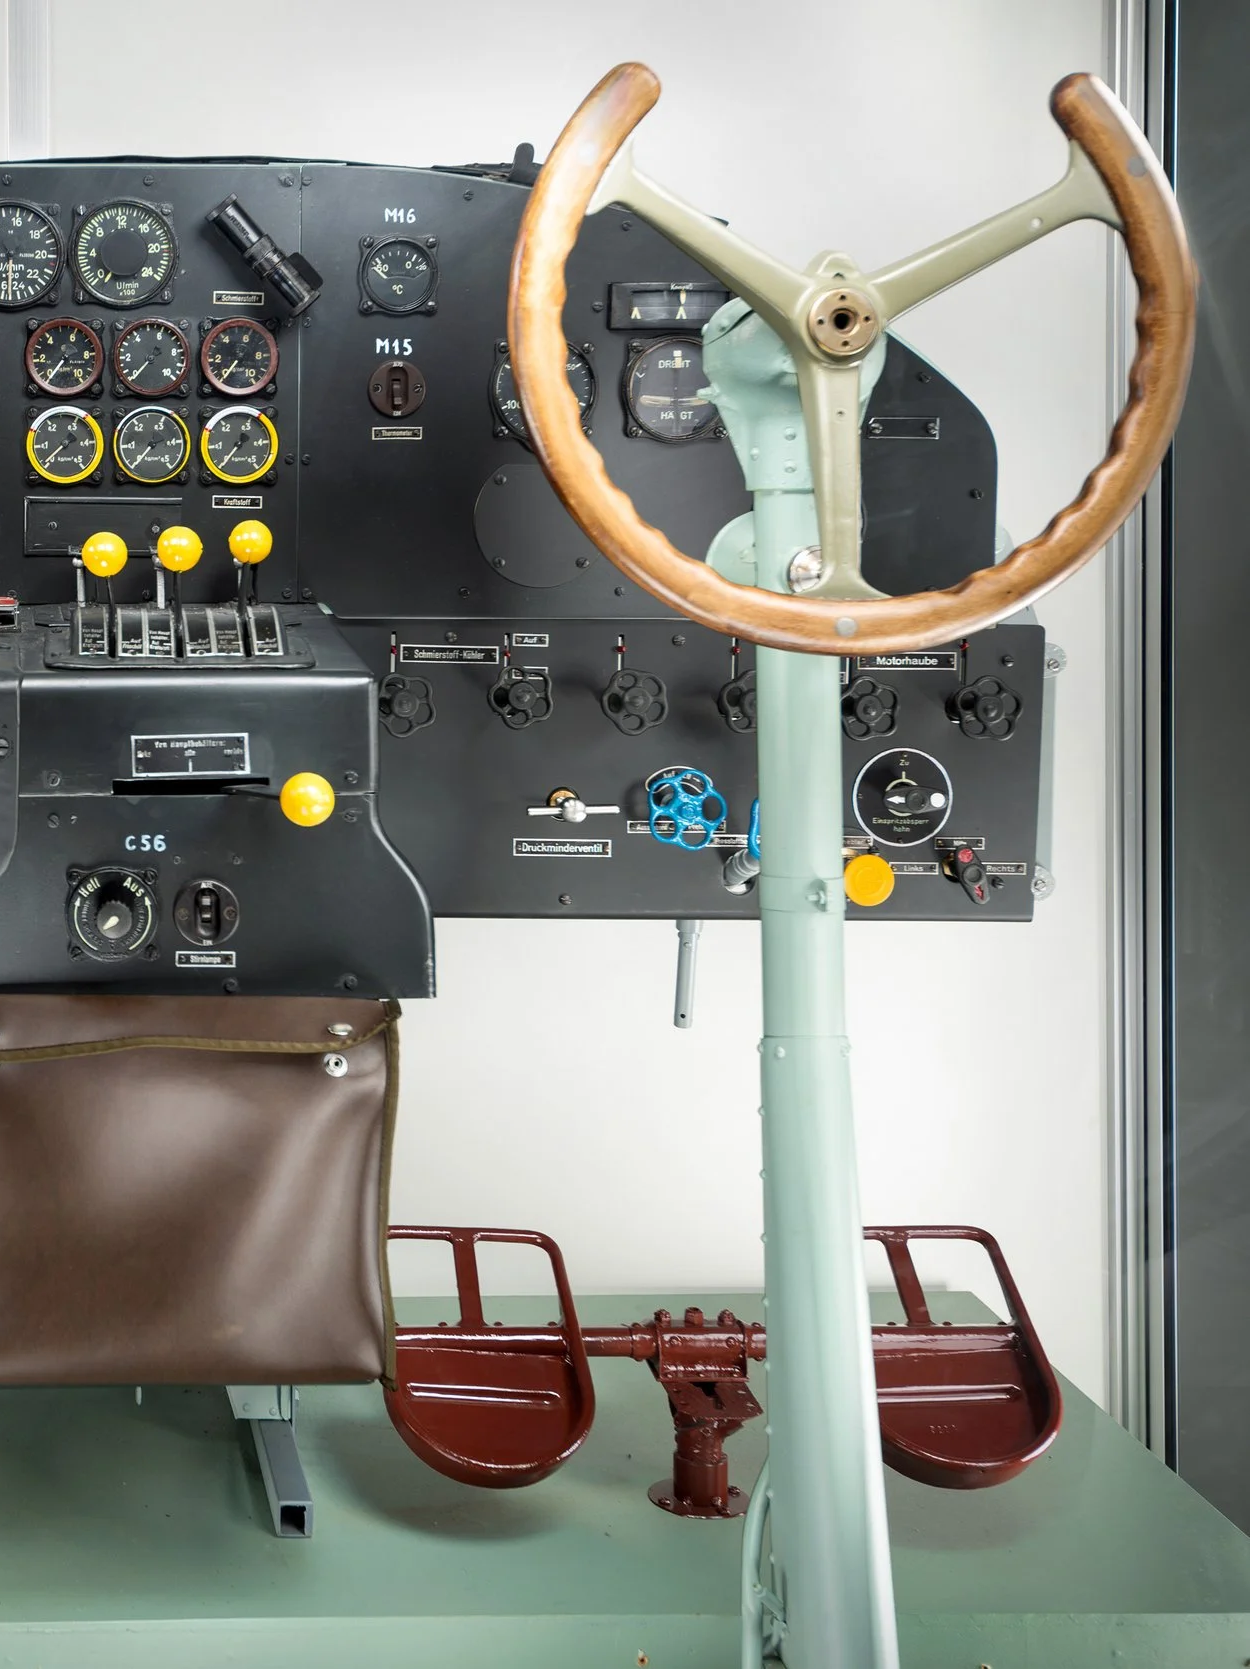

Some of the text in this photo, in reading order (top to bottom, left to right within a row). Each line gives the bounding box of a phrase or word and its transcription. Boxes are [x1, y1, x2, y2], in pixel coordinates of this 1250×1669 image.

[384, 207, 416, 224] M16
[11, 217, 23, 227] 16
[116, 215, 127, 226] 12
[96, 227, 104, 238] 8
[138, 223, 150, 233] 16
[29, 230, 41, 239] 18
[89, 248, 97, 257] 4
[147, 243, 161, 253] 20
[34, 250, 47, 259] 20
[405, 261, 412, 269] 0
[26, 269, 39, 279] 22
[97, 269, 105, 278] 0
[141, 266, 154, 278] 24
[1, 281, 8, 290] 6
[12, 281, 25, 290] 24
[116, 282, 139, 290] U/min
[47, 336, 53, 344] 4
[69, 334, 76, 342] 6
[156, 332, 163, 341] 6
[223, 335, 230, 344] 4
[243, 334, 249, 343] 6
[375, 337, 413, 356] M15
[83, 351, 90, 359] 8
[171, 347, 177, 356] 8
[255, 351, 262, 360] 8
[39, 354, 46, 363] 2
[125, 353, 131, 362] 2
[215, 355, 222, 363] 2
[73, 368, 83, 377] 10
[161, 368, 172, 377] 10
[245, 368, 256, 377] 10
[523, 636, 538, 644] Auf
[876, 656, 938, 666] Motorhaube
[522, 842, 603, 853] Druckminderventil
[78, 877, 101, 898] Hell
[123, 877, 145, 898] Aus
